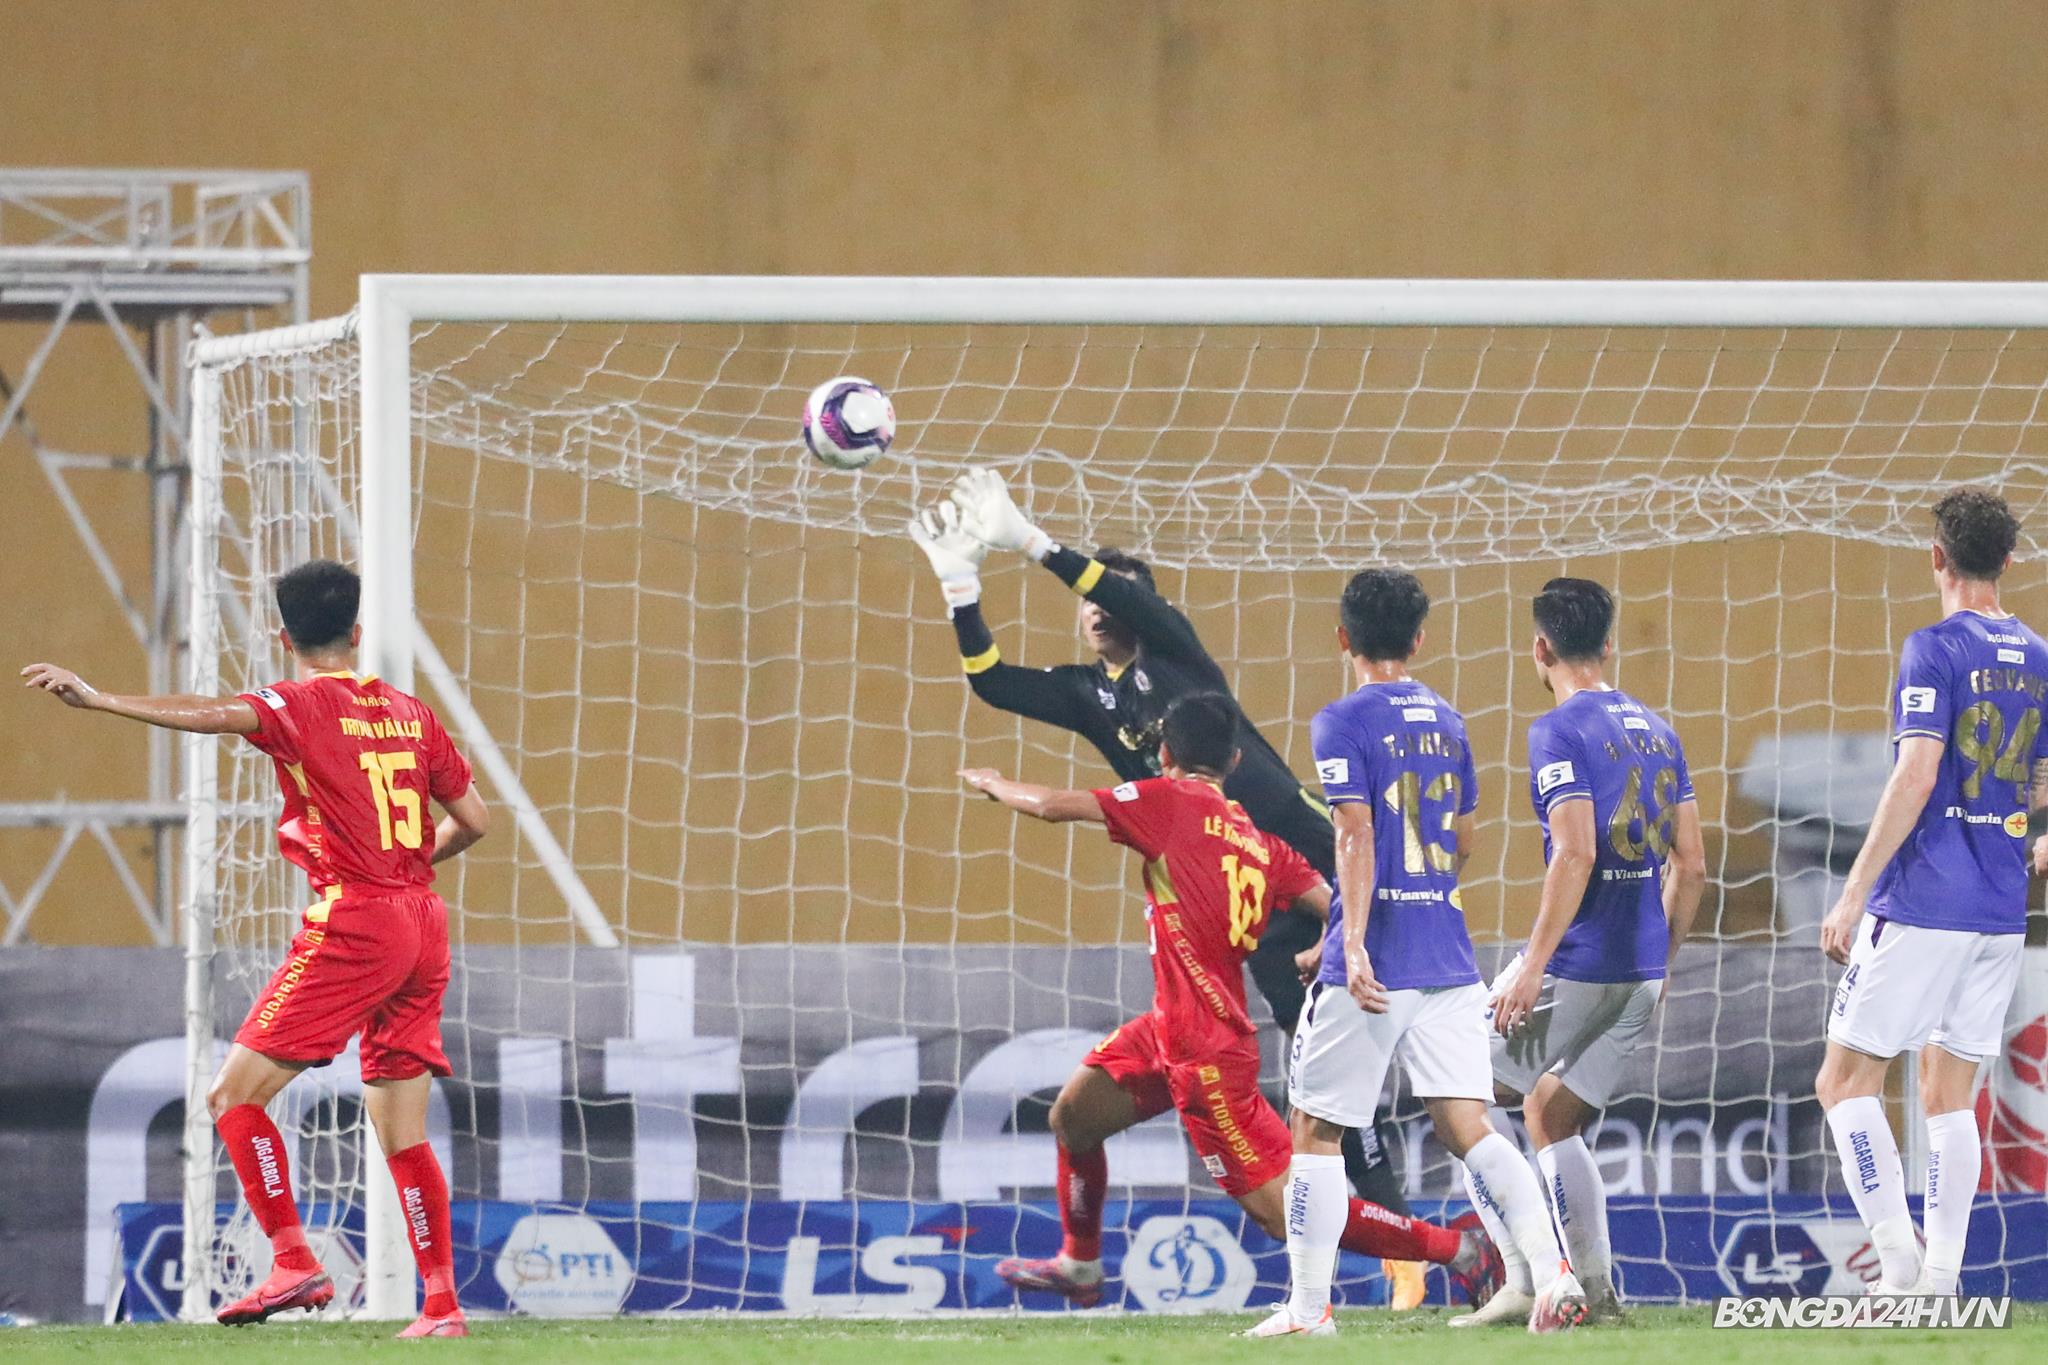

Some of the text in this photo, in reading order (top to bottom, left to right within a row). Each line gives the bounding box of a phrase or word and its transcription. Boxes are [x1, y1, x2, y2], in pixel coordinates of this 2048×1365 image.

[1956, 700, 2041, 804] 94
[359, 751, 423, 850] 15
[1384, 771, 1461, 875] 13
[1608, 766, 1678, 862] 68
[256, 948, 316, 1030] JOGARBOLA
[252, 1136, 285, 1199] JOGARBOLA
[1850, 1130, 1881, 1195] JOGARBOLA
[403, 1187, 432, 1251] JOGARBOLA
[1290, 1177, 1311, 1237] JOGARBOLA
[1360, 1203, 1412, 1232] JOGARBOLA
[560, 1253, 613, 1277] PTI
[781, 1235, 947, 1310] LS
[1742, 1252, 1803, 1285] LS
